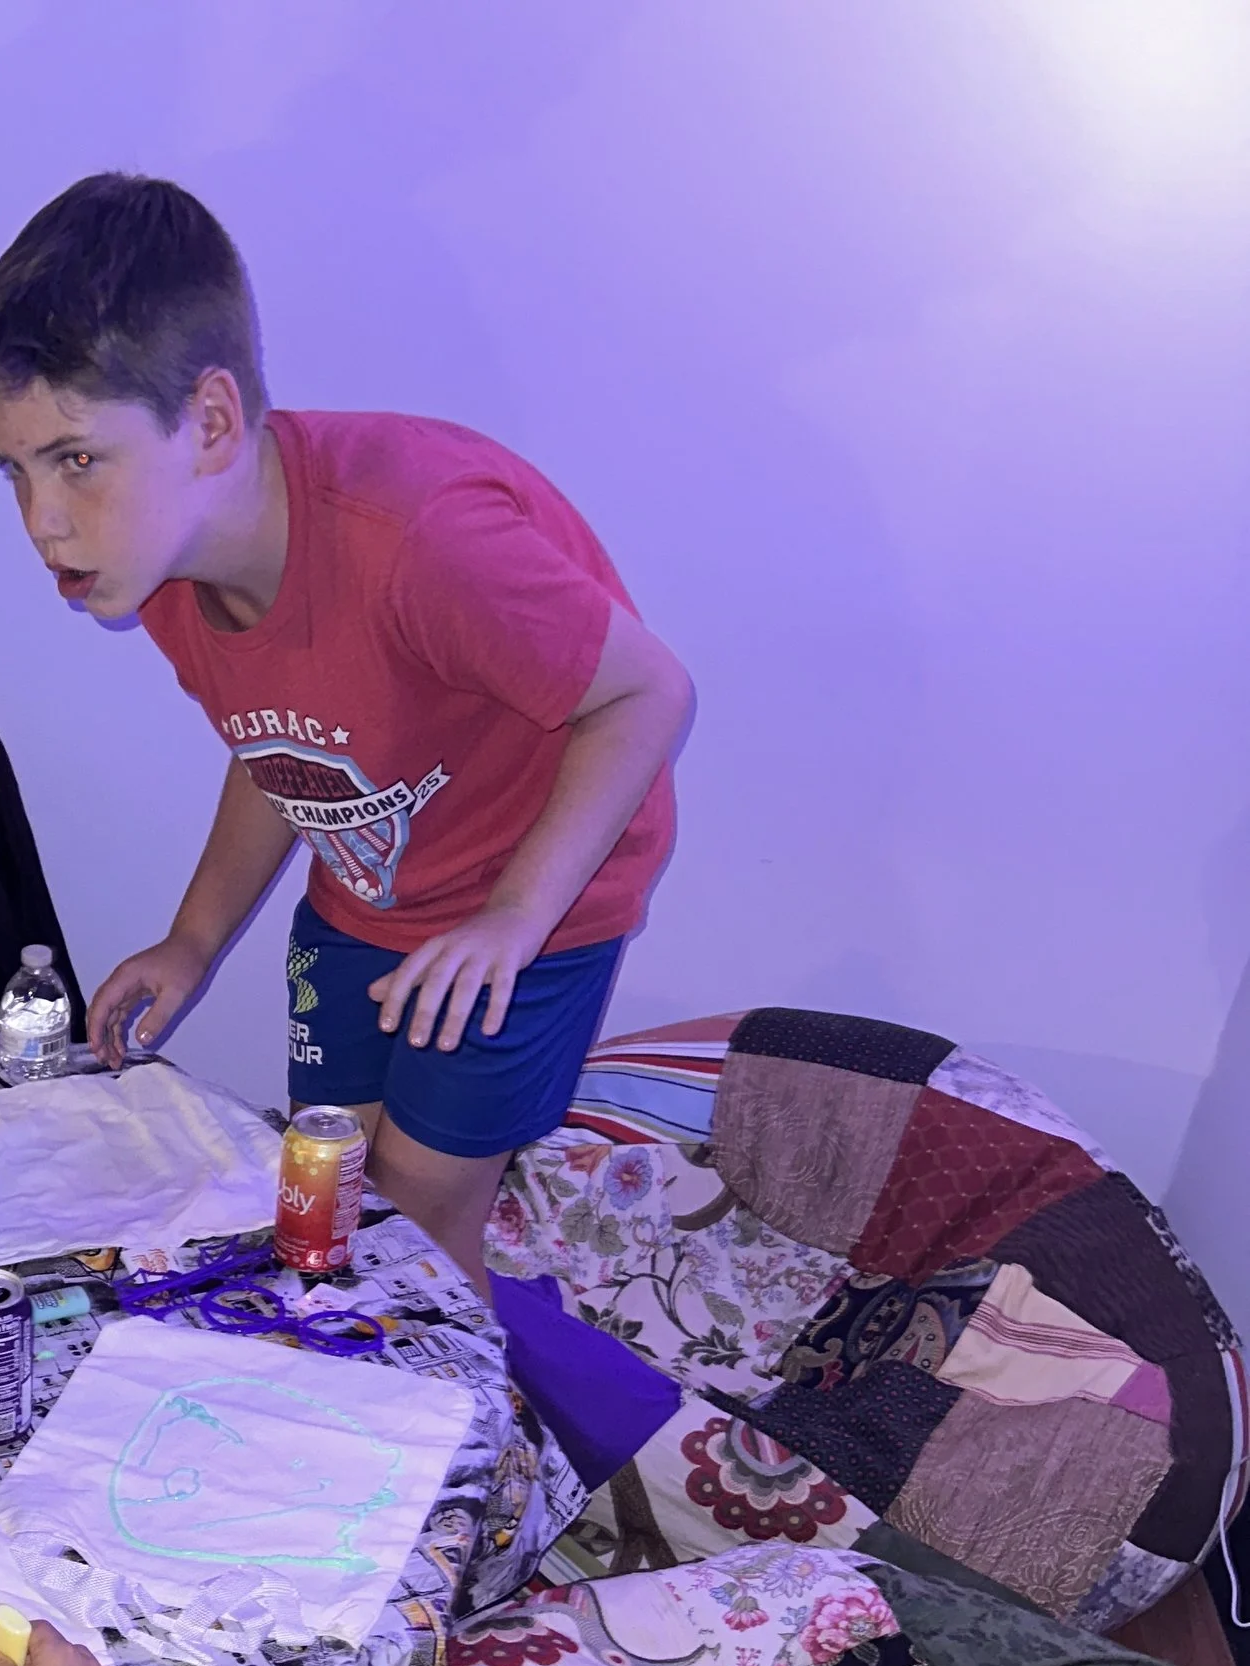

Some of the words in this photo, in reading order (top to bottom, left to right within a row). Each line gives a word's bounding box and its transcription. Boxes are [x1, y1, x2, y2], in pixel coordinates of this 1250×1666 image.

[221, 708, 326, 746] OJRAC
[292, 788, 408, 826] CHAMPIONS
[417, 773, 440, 800] 25
[278, 1177, 316, 1216] bly
